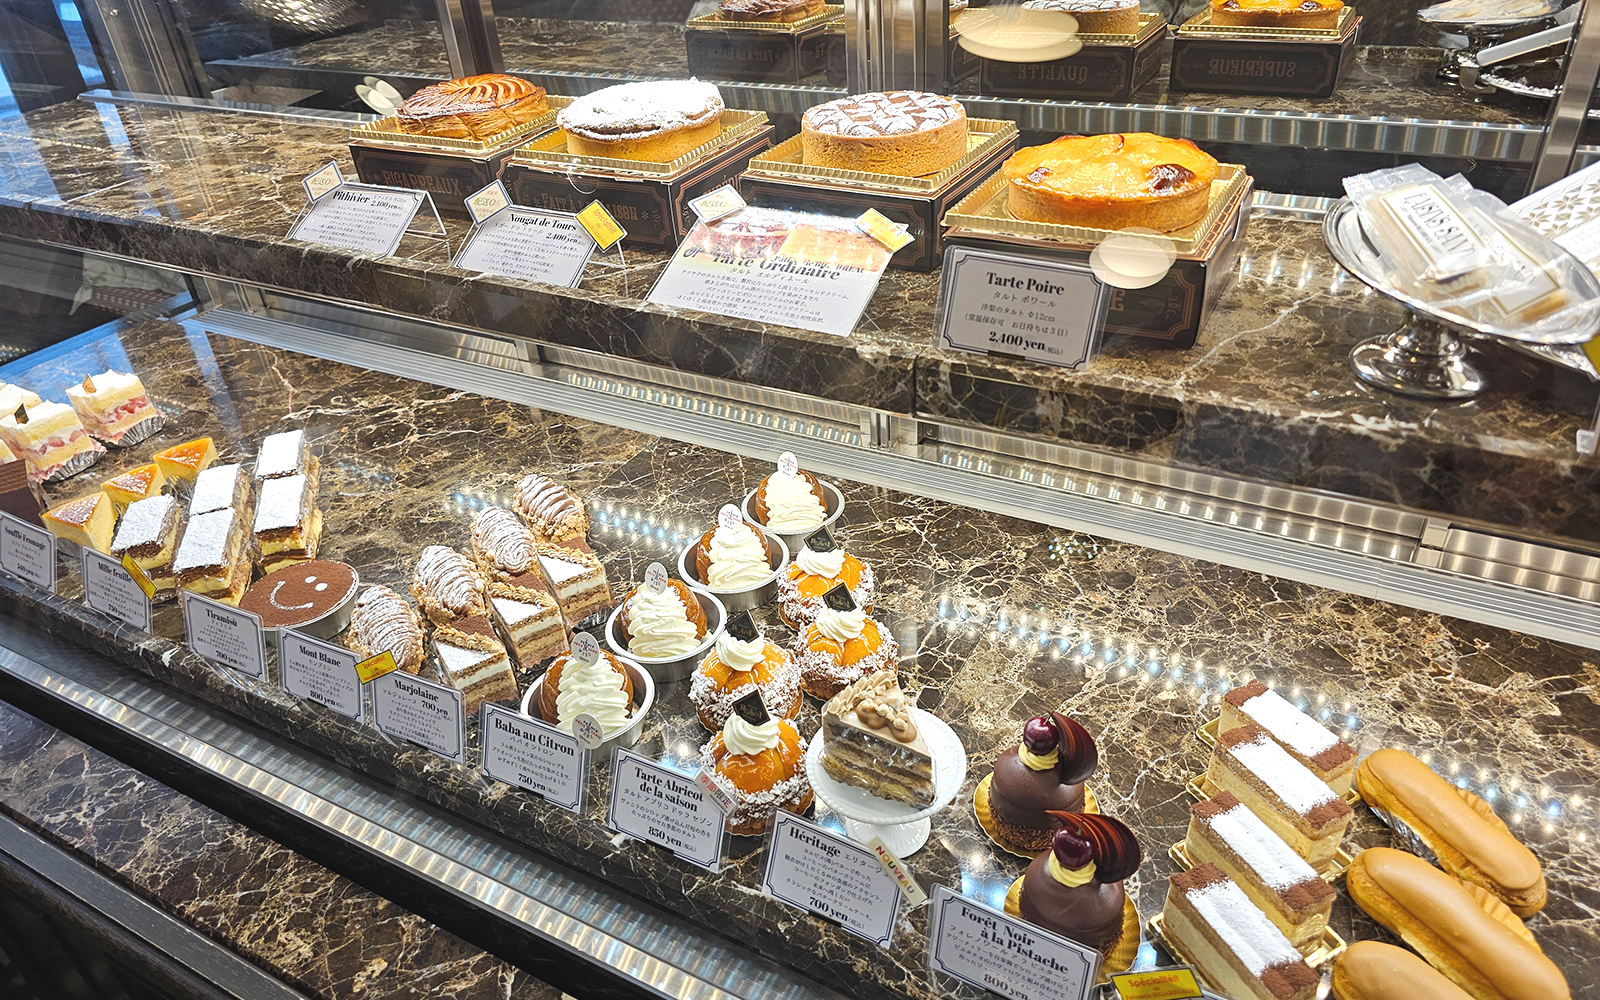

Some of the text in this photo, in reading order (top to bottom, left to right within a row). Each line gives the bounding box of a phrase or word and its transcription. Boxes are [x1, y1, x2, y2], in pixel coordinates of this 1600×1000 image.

[329, 191, 373, 202] Pithivier
[506, 213, 579, 231] Nougat de Tours
[728, 266, 753, 276] タルト
[756, 256, 845, 280] Ordinaire
[985, 271, 1065, 295] Tarte Poire
[980, 302, 1024, 317] 洋梨のタルト
[992, 290, 1057, 308] タルト ポワール
[988, 330, 1023, 347] 2,400
[1023, 339, 1046, 353] yen
[98, 561, 112, 575] Mille
[112, 568, 132, 583] feuille
[299, 644, 341, 667] Mont Blanc
[309, 689, 323, 701] 800
[323, 696, 335, 708] yen
[394, 679, 439, 704] Marjolaine
[421, 699, 435, 711] 700
[436, 706, 448, 717] yen
[494, 716, 521, 737] Baba
[522, 730, 535, 743] au
[537, 732, 574, 758] Citron
[518, 772, 532, 786] 750
[532, 780, 546, 793] yen
[623, 787, 641, 800] タルト
[634, 766, 704, 803] Tarte Abricot
[701, 774, 733, 808] 季節限定
[639, 780, 652, 795] de
[653, 785, 663, 799] la
[664, 790, 698, 813] saison
[648, 824, 665, 841] 850
[665, 833, 682, 850] yen
[788, 825, 842, 861] Héritage
[875, 845, 915, 894] NOUVEAU
[808, 895, 829, 913] 700
[829, 906, 849, 924] yen
[960, 905, 1035, 948] Forêt Noir
[980, 926, 1069, 975] à la Pistache
[983, 972, 1029, 1000] 800 yen
